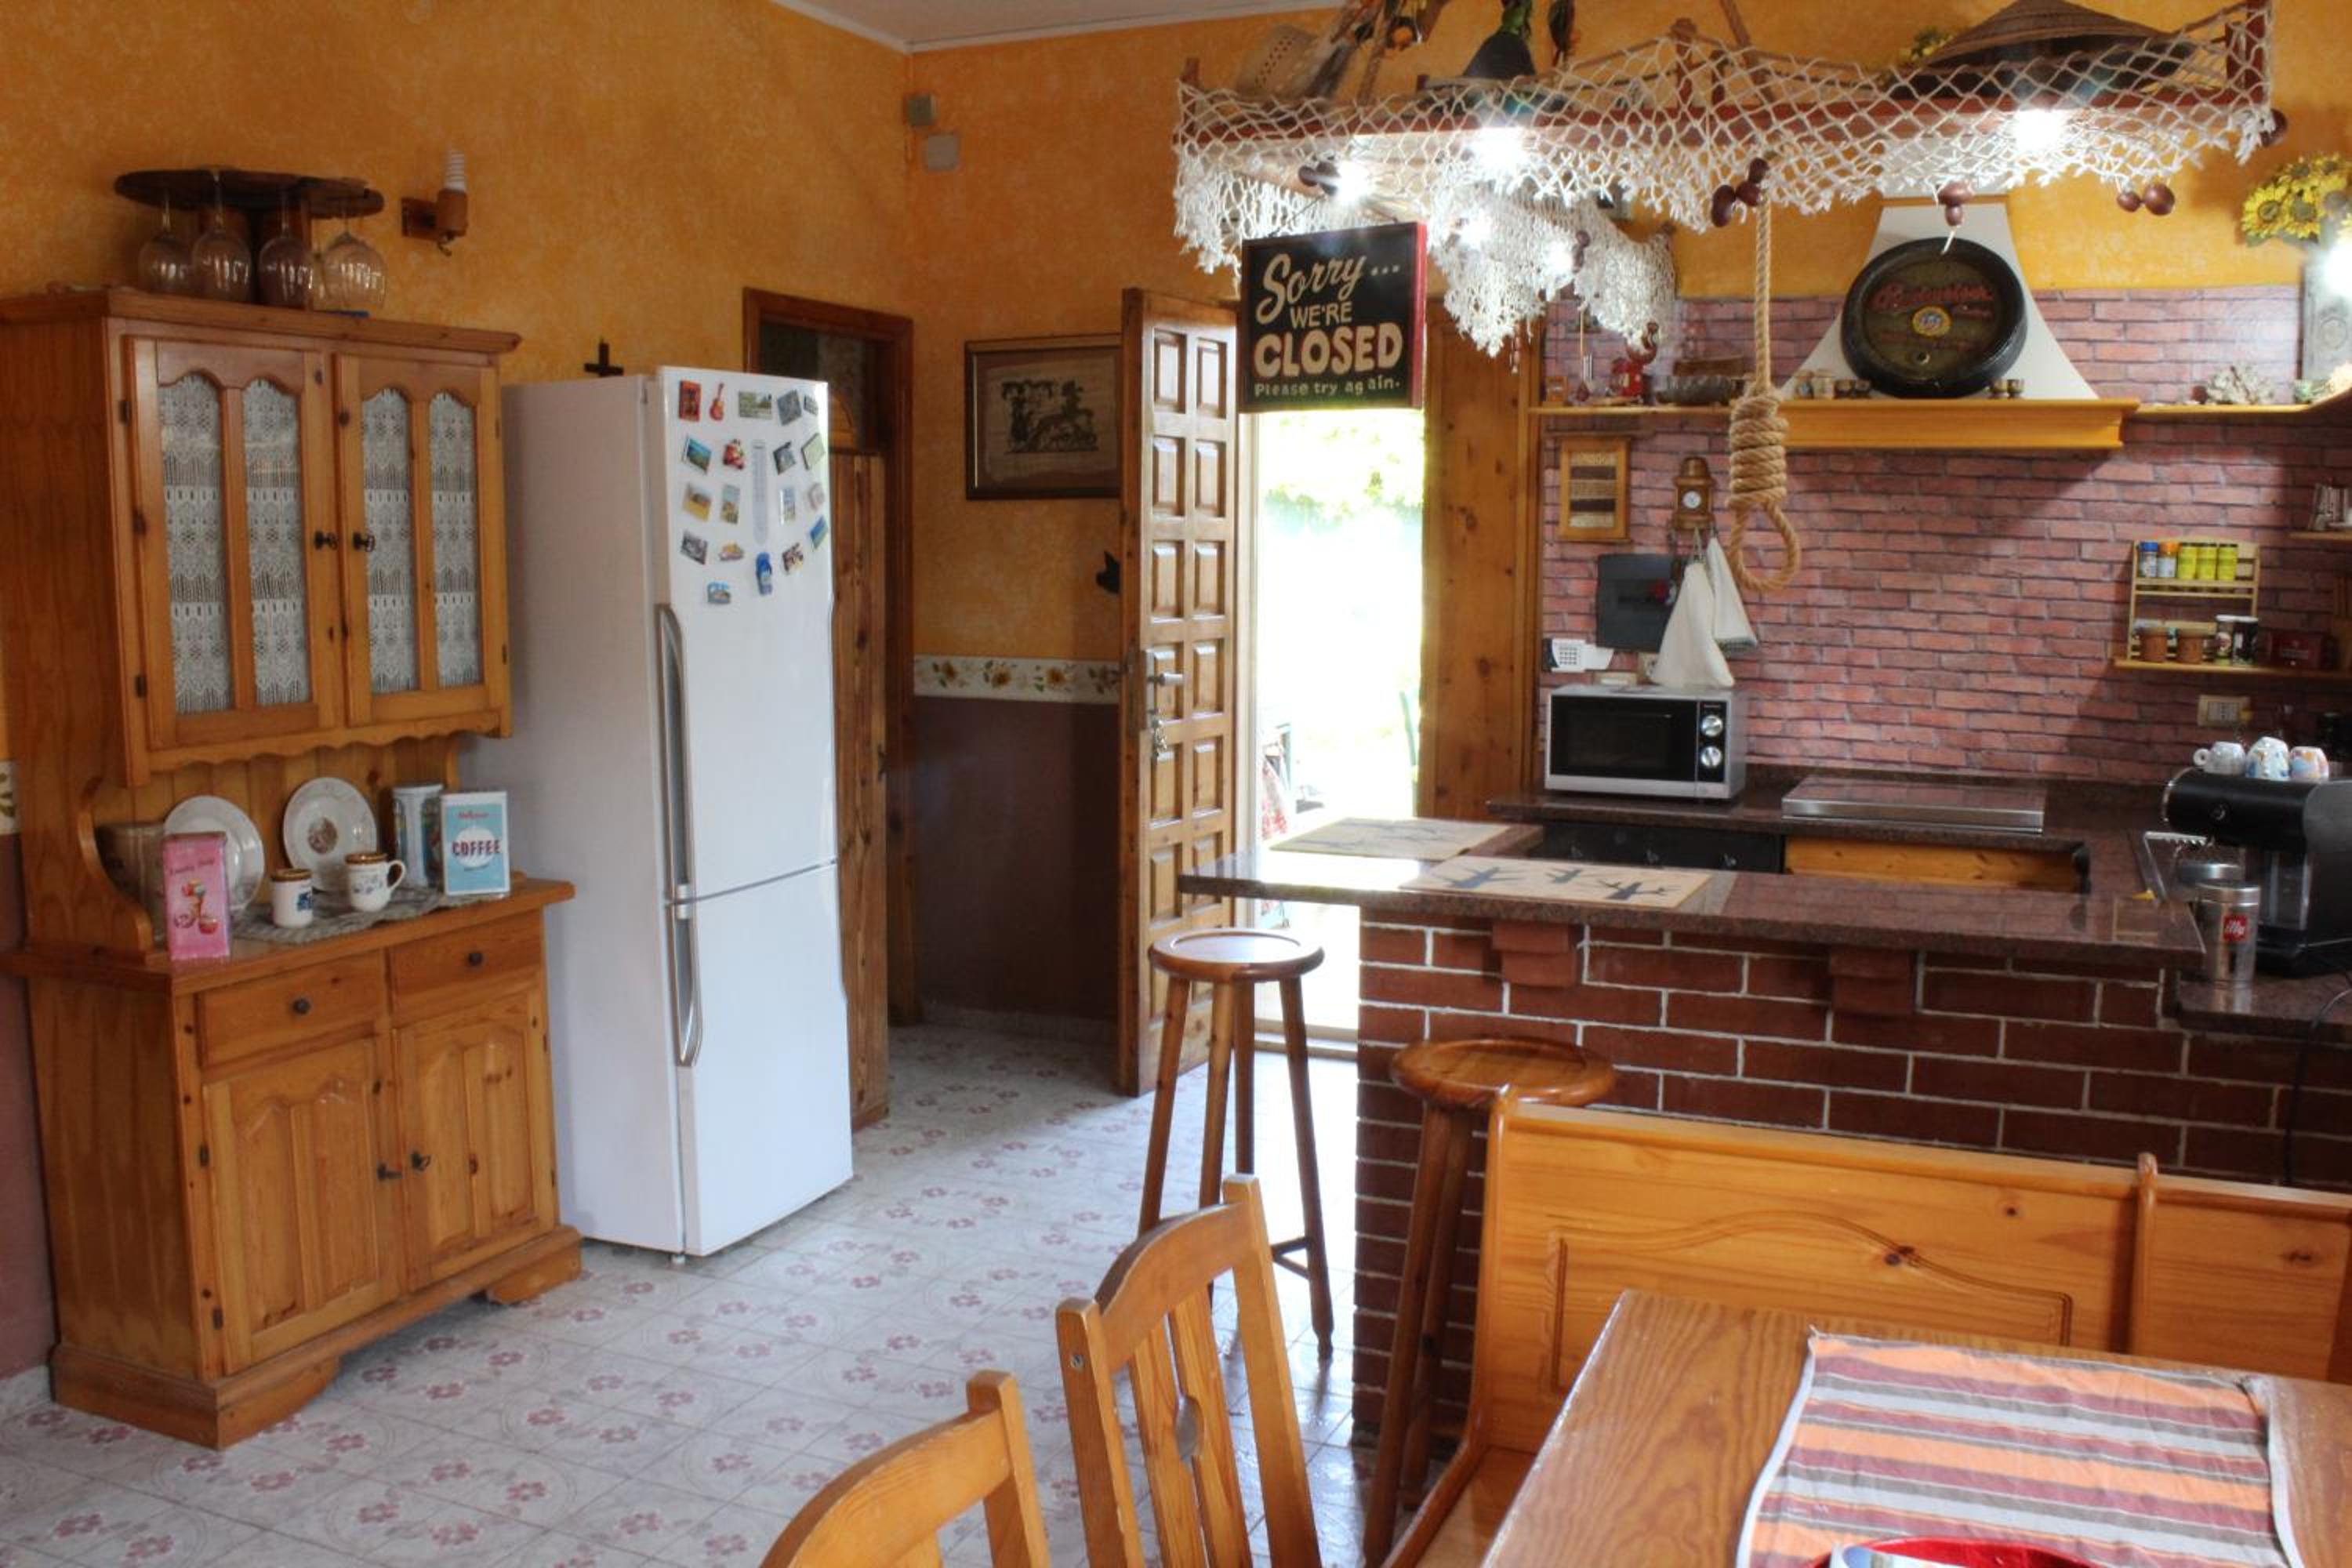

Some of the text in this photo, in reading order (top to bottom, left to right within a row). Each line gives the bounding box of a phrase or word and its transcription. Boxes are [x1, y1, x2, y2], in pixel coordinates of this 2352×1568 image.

[1290, 301, 1353, 329] WE'RE
[1254, 321, 1403, 378] CLOSED
[1254, 379, 1308, 397] Please
[1313, 379, 1338, 396] try
[452, 840, 503, 858] COFFEE
